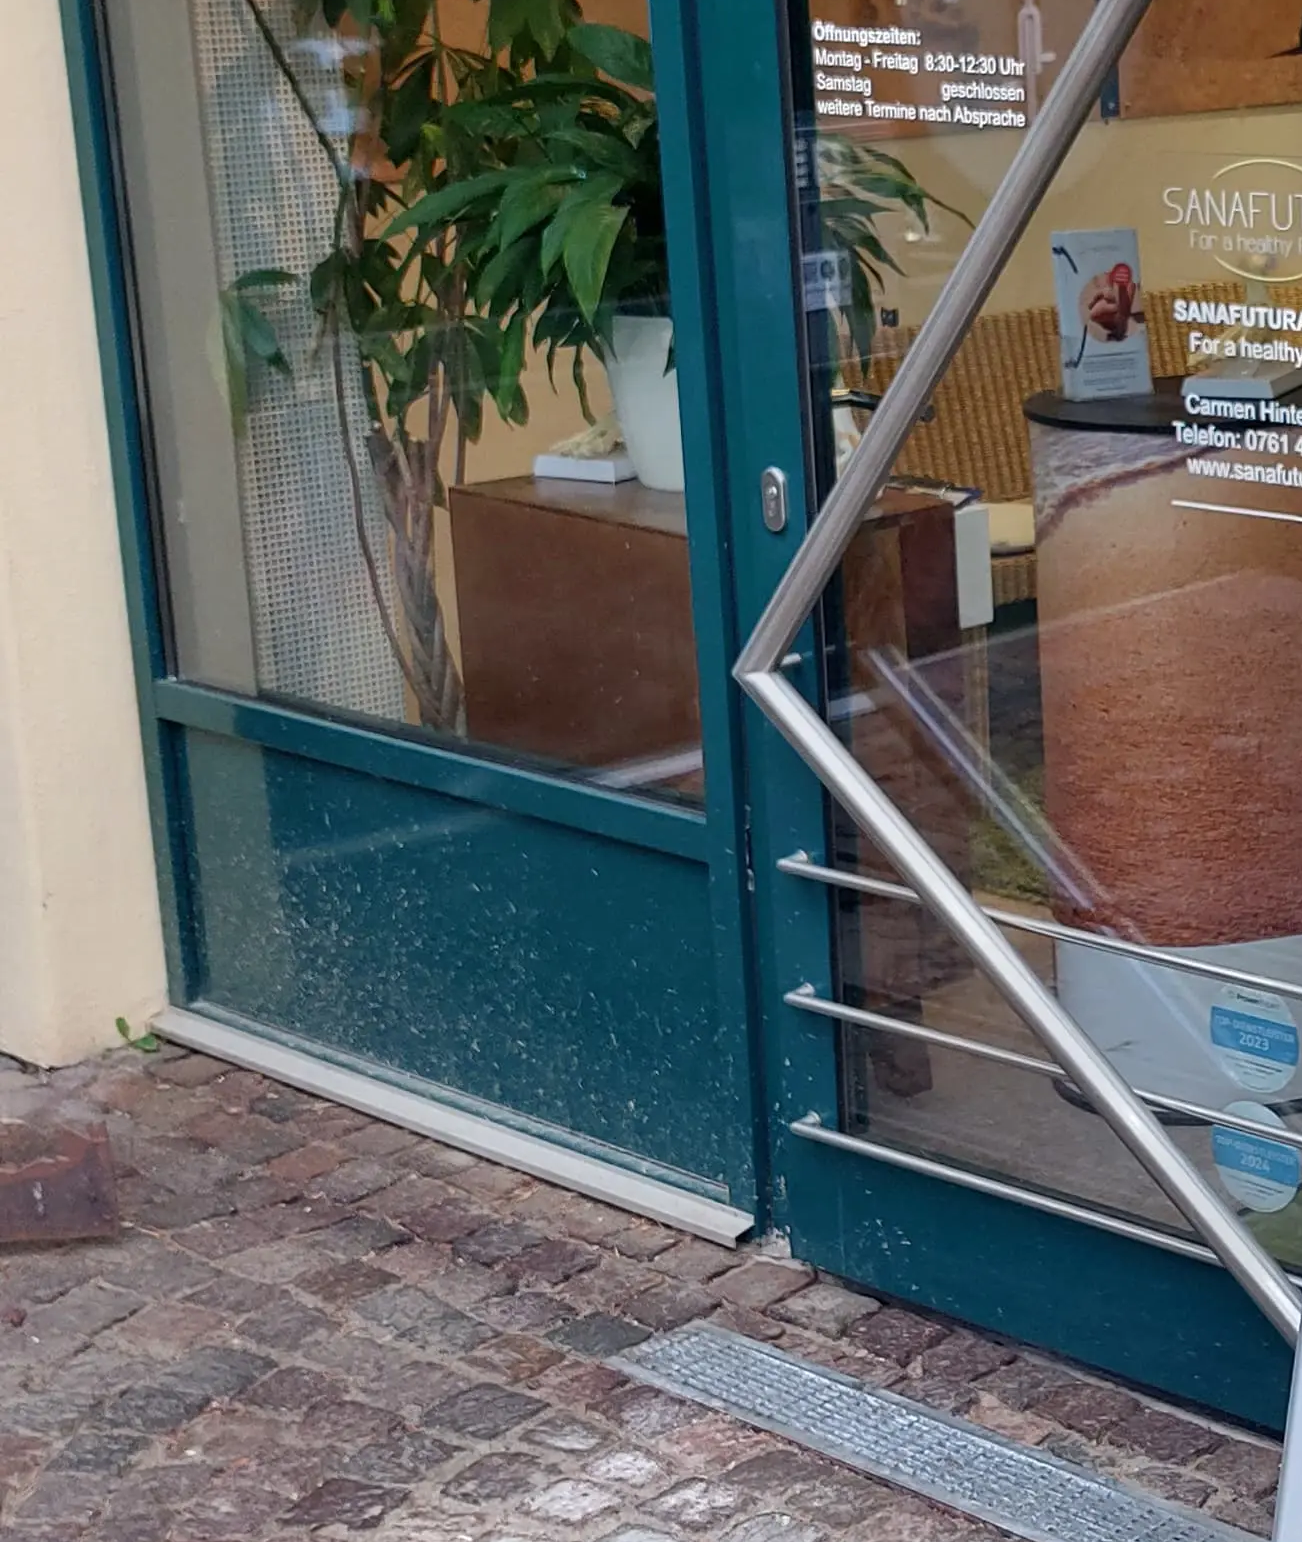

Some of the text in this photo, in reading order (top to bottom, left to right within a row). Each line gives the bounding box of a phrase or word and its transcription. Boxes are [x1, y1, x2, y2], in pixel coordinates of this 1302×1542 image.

[813, 20, 922, 47] Öffnungszeiten:
[814, 48, 862, 71] Montag
[873, 51, 919, 74] Freitag
[924, 53, 997, 75] 8:30-12:30
[999, 57, 1026, 76] Uhr
[816, 72, 1025, 102] Samstag geschlossen
[817, 99, 1026, 129] weitere Termine nach Absprache
[1189, 229, 1219, 251] For
[1222, 238, 1233, 252] a
[1236, 232, 1293, 258] healthy
[1188, 332, 1221, 355] For
[1224, 341, 1236, 357] a
[1184, 394, 1256, 420] Carmen
[1172, 421, 1242, 449] Telefon:
[1244, 430, 1289, 454] 0761
[1239, 1031, 1269, 1051] 2023
[1240, 1153, 1271, 1173] 2024
